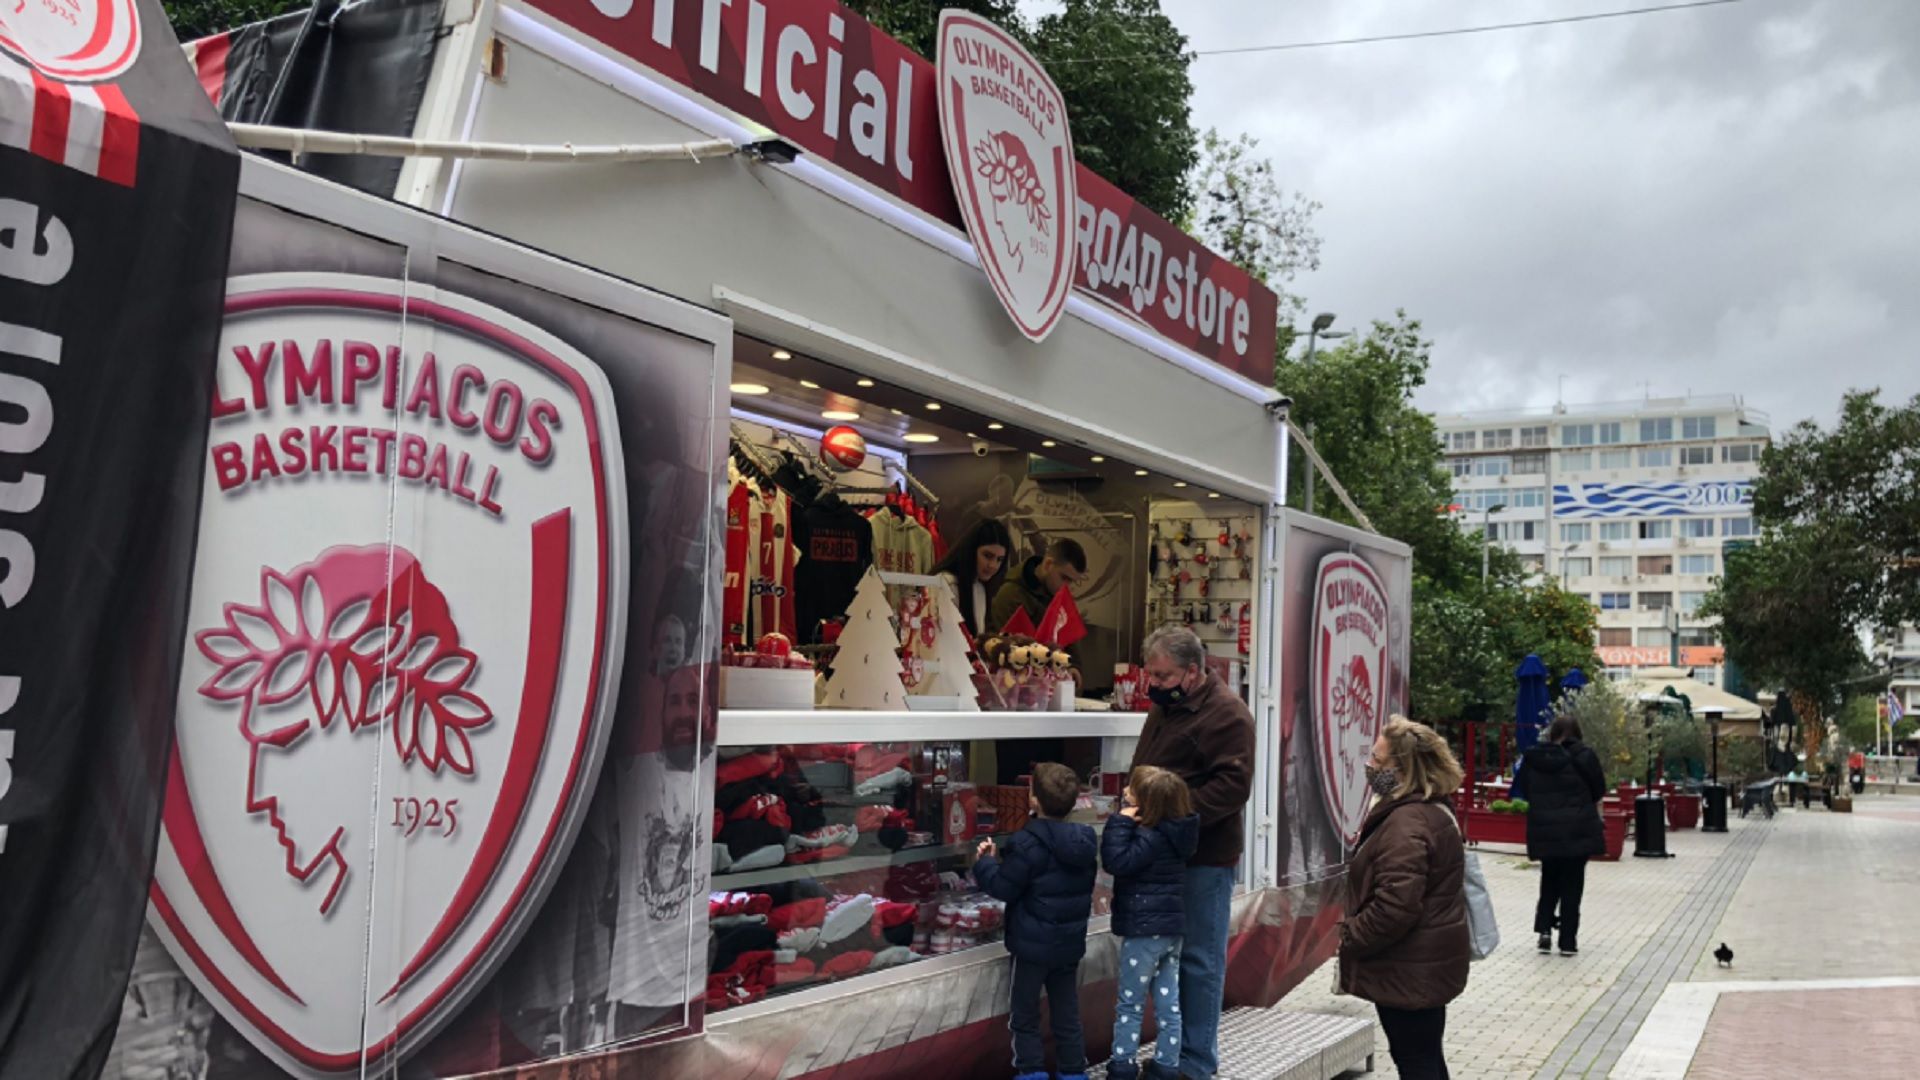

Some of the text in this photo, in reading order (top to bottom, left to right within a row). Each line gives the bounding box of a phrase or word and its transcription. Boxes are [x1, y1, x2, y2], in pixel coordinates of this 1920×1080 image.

[953, 36, 1057, 126] OLYMPIACOS
[970, 75, 1046, 140] BASKETBALL
[1077, 197, 1163, 313] ROAD
[1163, 251, 1250, 356] store
[211, 339, 560, 462] LYMPIACOS
[212, 425, 503, 515] BASKETBALL
[762, 541, 772, 565] 7
[390, 797, 459, 838] 1925
